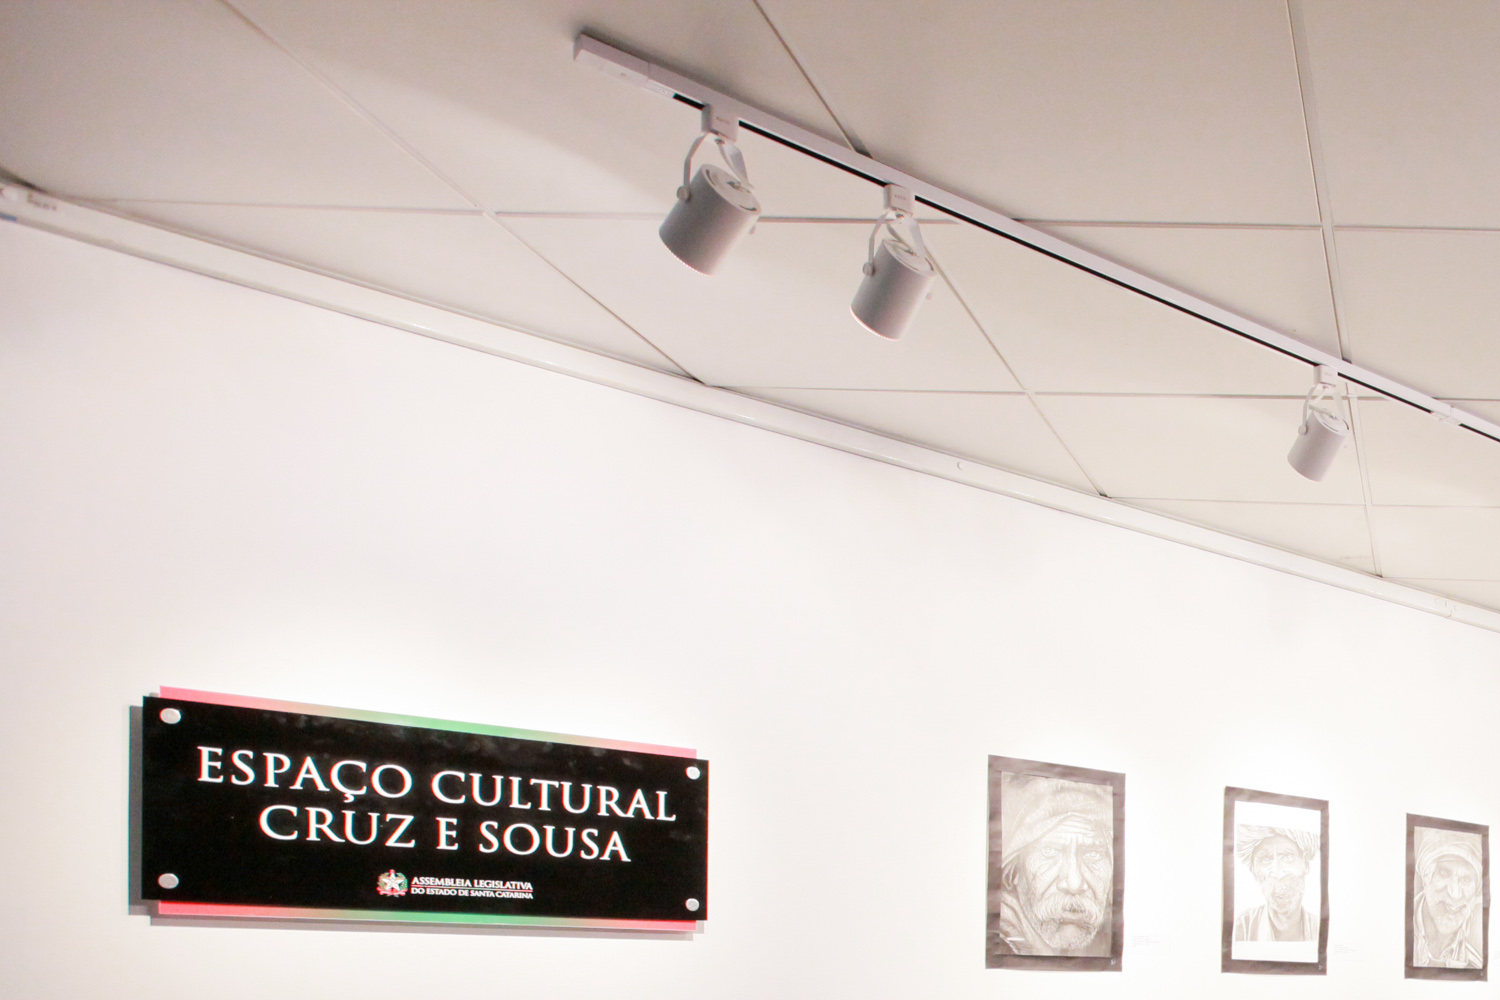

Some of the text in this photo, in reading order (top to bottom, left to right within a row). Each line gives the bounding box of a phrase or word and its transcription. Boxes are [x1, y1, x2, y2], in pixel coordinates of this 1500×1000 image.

[197, 746, 677, 821] ESPAÇO CULTURAL
[258, 805, 632, 862] CRUZ E SOUSA
[411, 876, 533, 890] ASSEMBLEIA LEGISLATIVA
[426, 888, 457, 896] ESTADO
[496, 891, 533, 899] CATARINA
